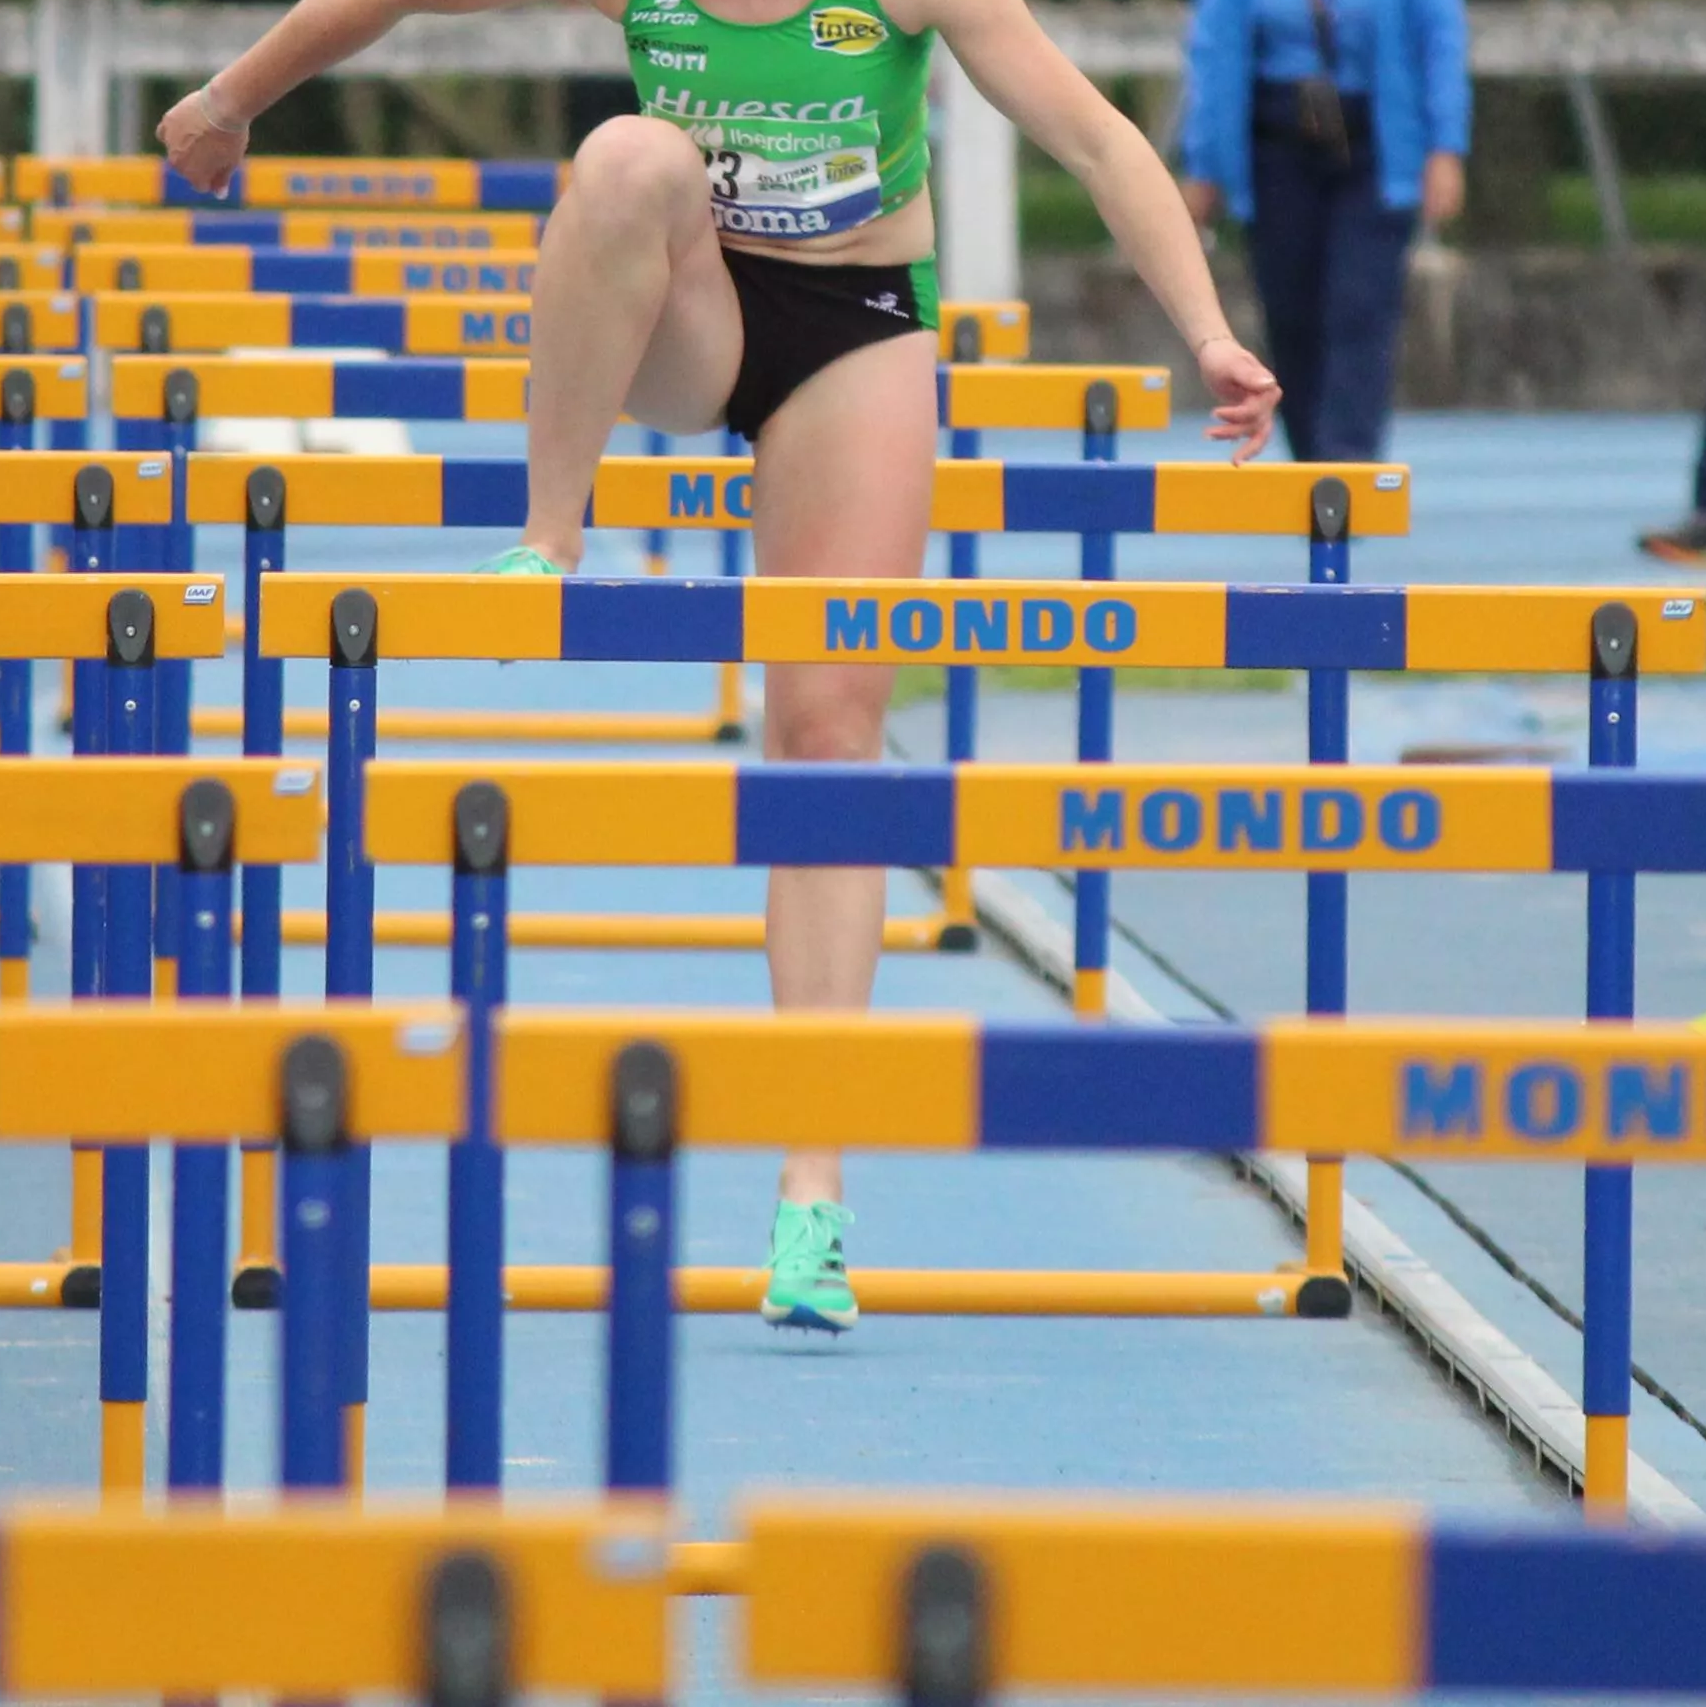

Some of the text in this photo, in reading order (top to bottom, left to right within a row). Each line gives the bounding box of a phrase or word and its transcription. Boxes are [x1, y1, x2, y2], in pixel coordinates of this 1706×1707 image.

[729, 126, 842, 153] Iberdrola
[825, 598, 1137, 652] MONDO
[1060, 788, 1442, 853] MONDO
